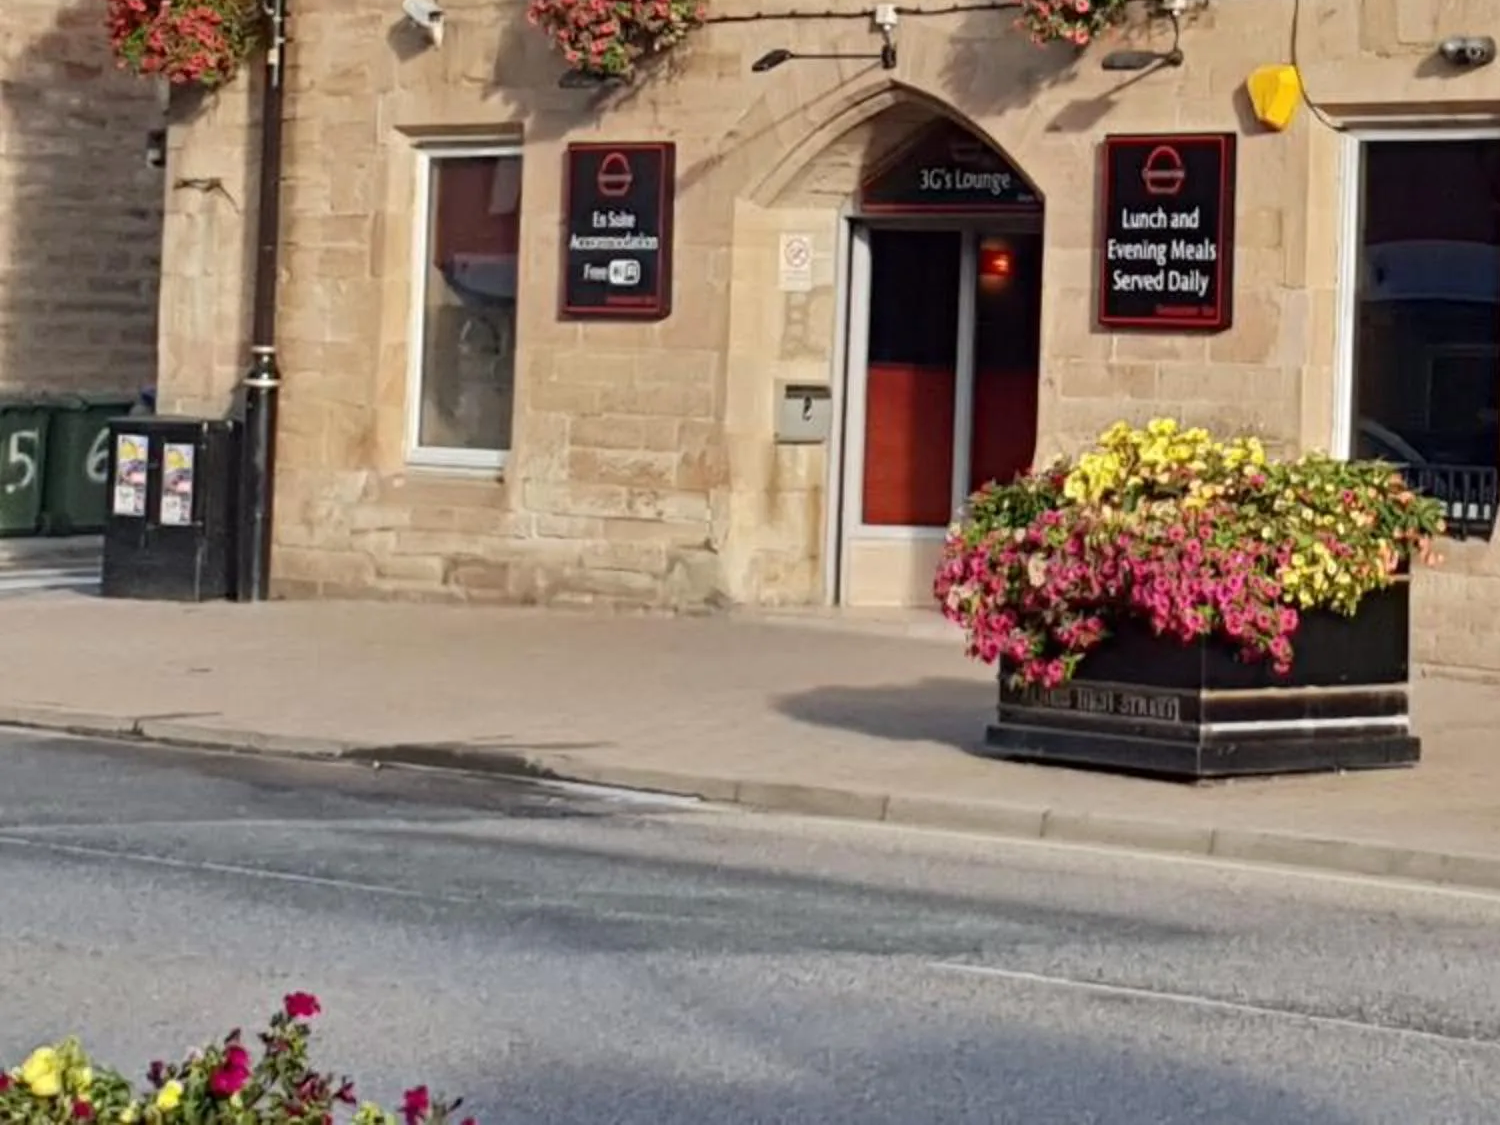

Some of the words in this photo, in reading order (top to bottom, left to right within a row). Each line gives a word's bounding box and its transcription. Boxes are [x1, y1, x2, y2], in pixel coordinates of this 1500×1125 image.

[955, 168, 1012, 195] Lounge
[1122, 207, 1168, 230] Lunch
[1170, 206, 1200, 230] and
[1108, 239, 1168, 266] Evening
[1170, 238, 1217, 261] Meals
[1113, 268, 1165, 293] Served
[1167, 269, 1210, 298] Daily
[5, 429, 39, 494] 5
